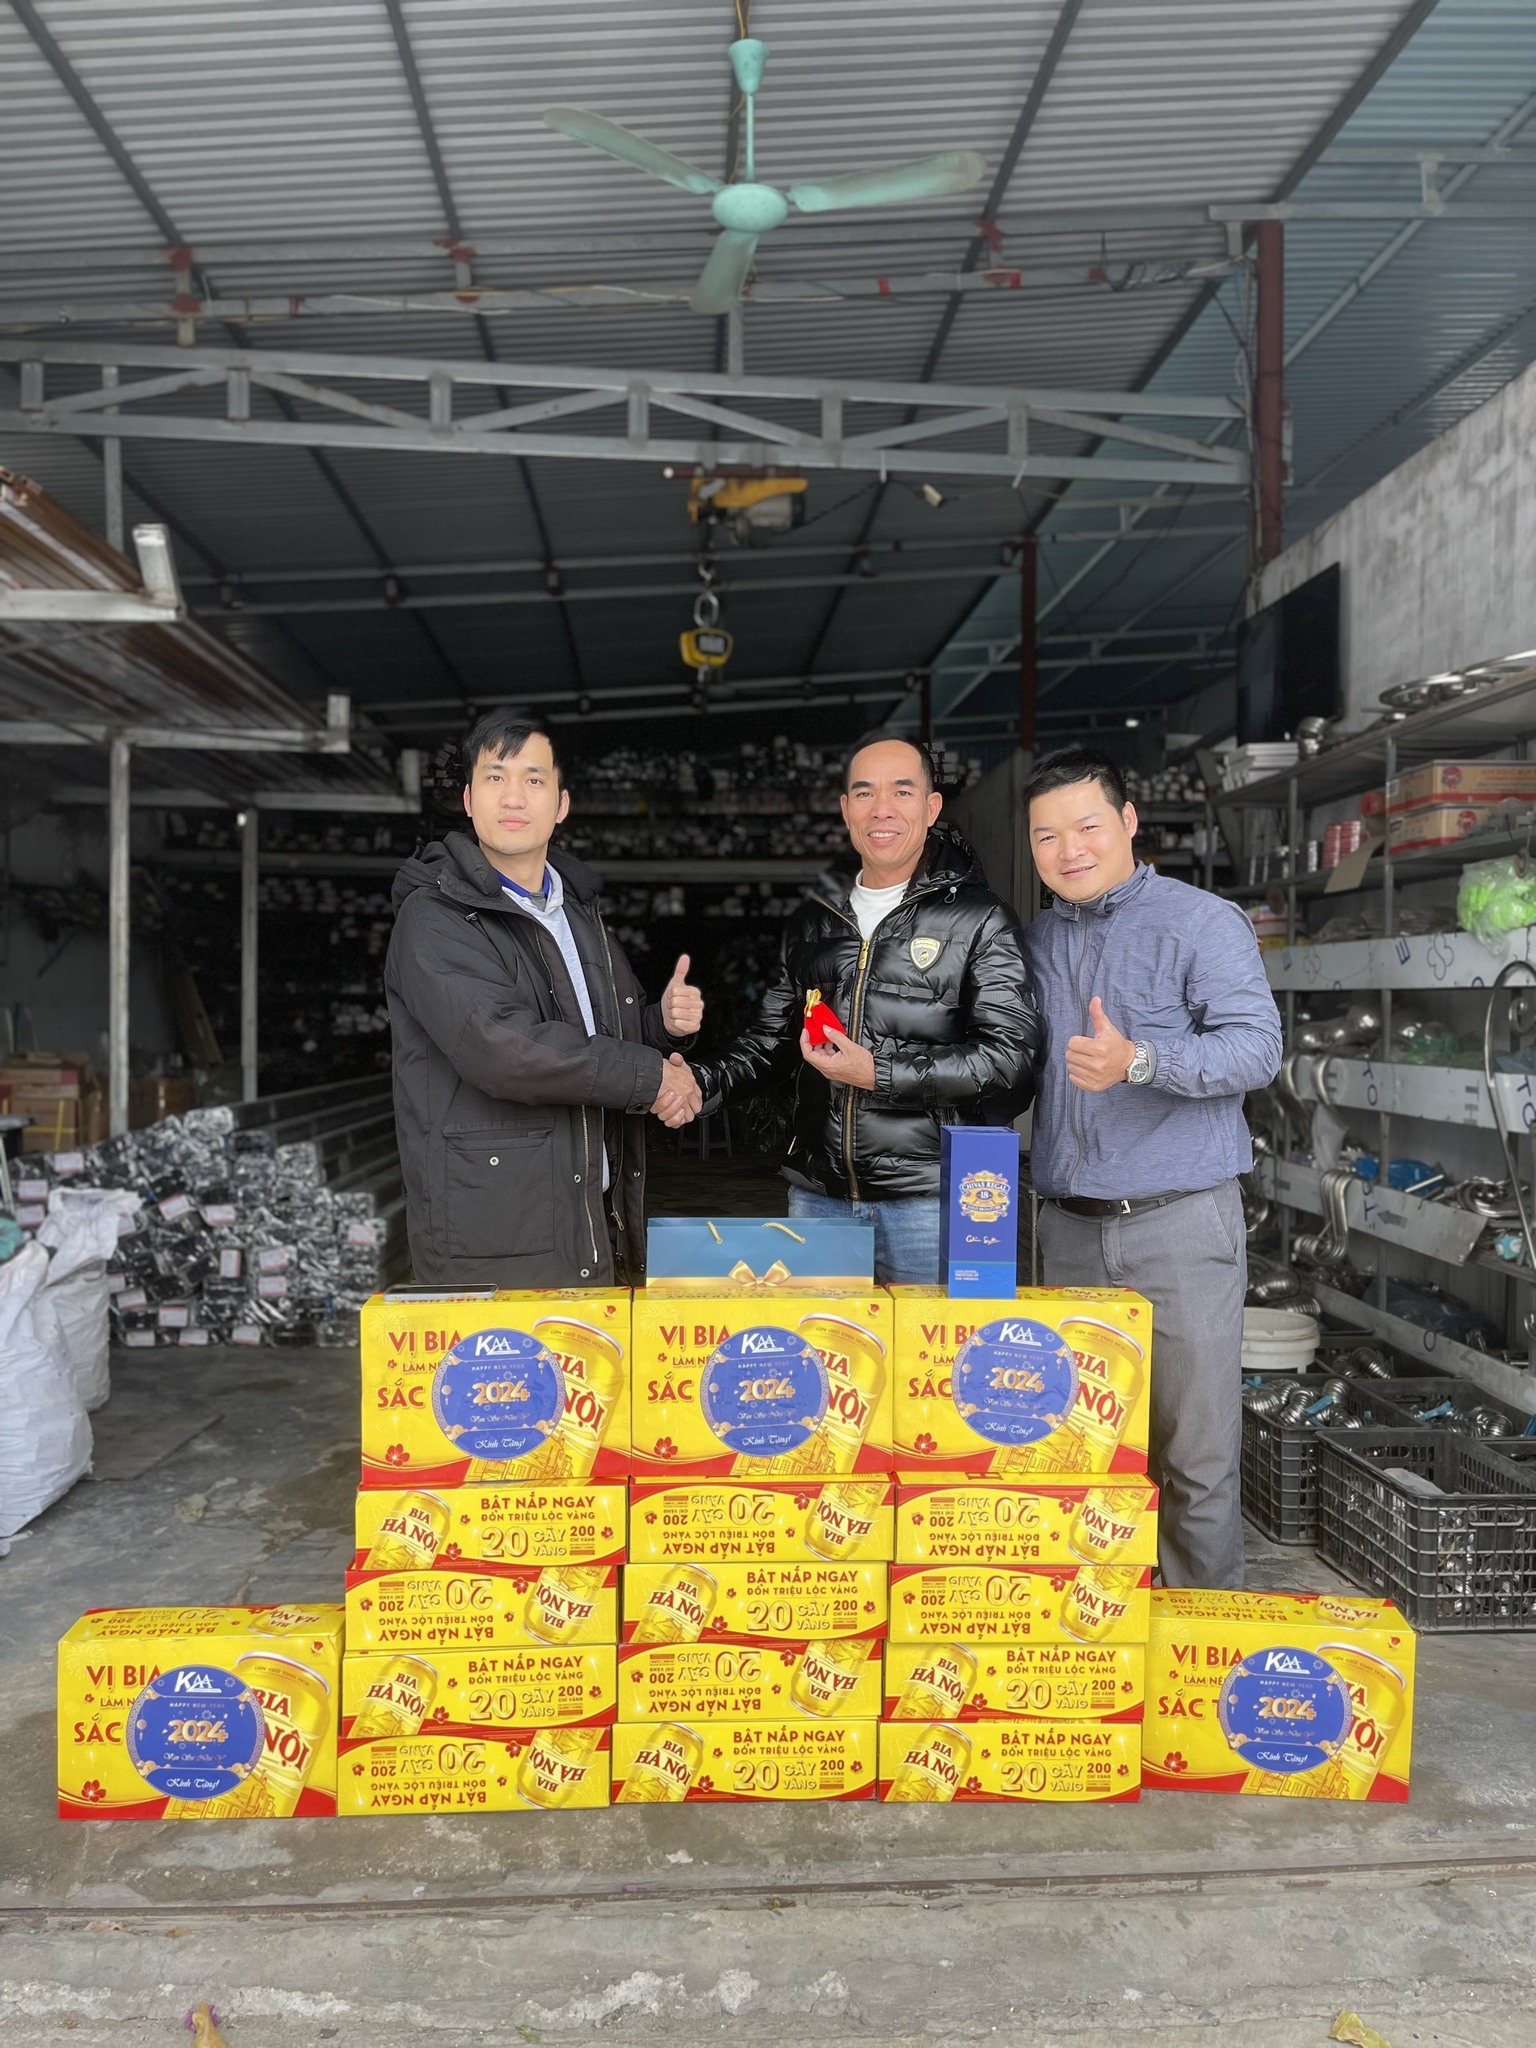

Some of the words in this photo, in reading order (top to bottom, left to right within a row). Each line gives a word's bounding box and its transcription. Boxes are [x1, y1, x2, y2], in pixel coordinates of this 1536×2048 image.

[388, 1332, 414, 1356] VỊ
[659, 1326, 684, 1349] VỊ
[920, 1324, 946, 1348] VỊ
[403, 1360, 425, 1372] LÀM
[673, 1354, 694, 1366] LÀM
[934, 1354, 954, 1364] LÀM
[648, 1372, 692, 1400] SẮC
[909, 1369, 952, 1398] SẮC
[990, 1367, 1045, 1392] 2024
[378, 1378, 424, 1407] SẮC
[472, 1380, 530, 1404] 2024
[738, 1378, 795, 1401] 2024
[1076, 1381, 1124, 1431] NỘI
[481, 1494, 510, 1512] BẬT
[516, 1491, 547, 1509] NẮP
[553, 1496, 595, 1508] NGAY
[729, 1494, 775, 1525] 20
[408, 1508, 431, 1524] BIA
[508, 1512, 538, 1523] TRIỆU
[542, 1511, 563, 1522] LỘC
[567, 1510, 595, 1520] VÀNG
[663, 1514, 688, 1525] 200
[929, 1516, 954, 1527] 200
[995, 1497, 1040, 1528] 20
[380, 1517, 407, 1535] HÀ
[410, 1524, 439, 1553] NỘI
[570, 1526, 595, 1536] 200
[481, 1527, 528, 1558] 20
[663, 1543, 704, 1555] NGAY
[710, 1542, 741, 1560] NẮP
[746, 1539, 775, 1557] BẬT
[929, 1544, 970, 1557] NGAY
[1011, 1542, 1039, 1560] BẬT
[976, 1544, 1006, 1562] NẮP
[747, 1568, 776, 1586] BẬT
[781, 1566, 812, 1583] NẮP
[817, 1570, 858, 1582] NGAY
[446, 1579, 493, 1610] 20
[676, 1581, 698, 1598] BIA
[773, 1586, 802, 1596] TRIỆU
[806, 1586, 826, 1596] LỘC
[830, 1584, 858, 1594] VÀNG
[379, 1601, 404, 1611] 200
[648, 1590, 674, 1608] HÀ
[677, 1598, 705, 1626] NỘI
[833, 1600, 858, 1610] 200
[747, 1600, 792, 1631] 20
[379, 1629, 422, 1641] NGAY
[427, 1628, 459, 1646] NẮP
[464, 1624, 493, 1642] BẬT
[920, 1623, 961, 1635] NGAY
[966, 1622, 997, 1640] NẮP
[1002, 1620, 1030, 1637] BẬT
[468, 1657, 498, 1675] BẬT
[503, 1652, 535, 1671] NẮP
[541, 1655, 583, 1669] NGAY
[1007, 1647, 1035, 1665] BẬT
[1040, 1645, 1071, 1662] NẮP
[1076, 1650, 1116, 1662] NGAY
[1171, 1644, 1196, 1668] VỊ
[937, 1658, 959, 1675] BIA
[1032, 1665, 1061, 1676] TRIỆU
[1065, 1665, 1085, 1676] LỘC
[1089, 1664, 1116, 1674] VÀNG
[86, 1665, 112, 1690] VỊ
[395, 1672, 418, 1690] BIA
[910, 1667, 935, 1685] HÀ
[938, 1674, 965, 1702] NỘI
[1091, 1680, 1115, 1690] 200
[1184, 1674, 1206, 1684] LÀM
[558, 1685, 583, 1697] 200
[1006, 1679, 1051, 1709] 20
[100, 1696, 123, 1707] LÀM
[366, 1683, 393, 1702] HÀ
[396, 1689, 426, 1718] NỘI
[469, 1688, 516, 1721] 20
[649, 1701, 690, 1713] NGAY
[696, 1699, 727, 1717] NẮP
[732, 1696, 761, 1714] BẬT
[1158, 1688, 1204, 1718] SẮC
[1259, 1696, 1316, 1720] 2024
[74, 1712, 121, 1742] SẮC
[168, 1720, 228, 1742] 2024
[733, 1728, 762, 1746] BẬT
[768, 1725, 798, 1743] NẮP
[804, 1730, 845, 1742] NGAY
[1001, 1730, 1030, 1748] BẬT
[1035, 1727, 1066, 1745] NẮP
[1071, 1733, 1112, 1745] NGAY
[662, 1740, 684, 1757] BIA
[759, 1746, 789, 1756] TRIỆU
[793, 1745, 813, 1756] LỘC
[817, 1744, 845, 1754] VÀNG
[931, 1741, 953, 1758] BIA
[634, 1750, 660, 1767] HÀ
[663, 1757, 691, 1785] NỘI
[820, 1760, 844, 1770] 200
[904, 1750, 929, 1768] HÀ
[932, 1757, 960, 1785] NỘI
[1087, 1763, 1111, 1773] 200
[733, 1760, 779, 1791] 20
[1001, 1761, 1046, 1792] 20
[371, 1794, 414, 1807] NGAY
[419, 1792, 451, 1811] NẮP
[456, 1789, 486, 1807] BẬT
